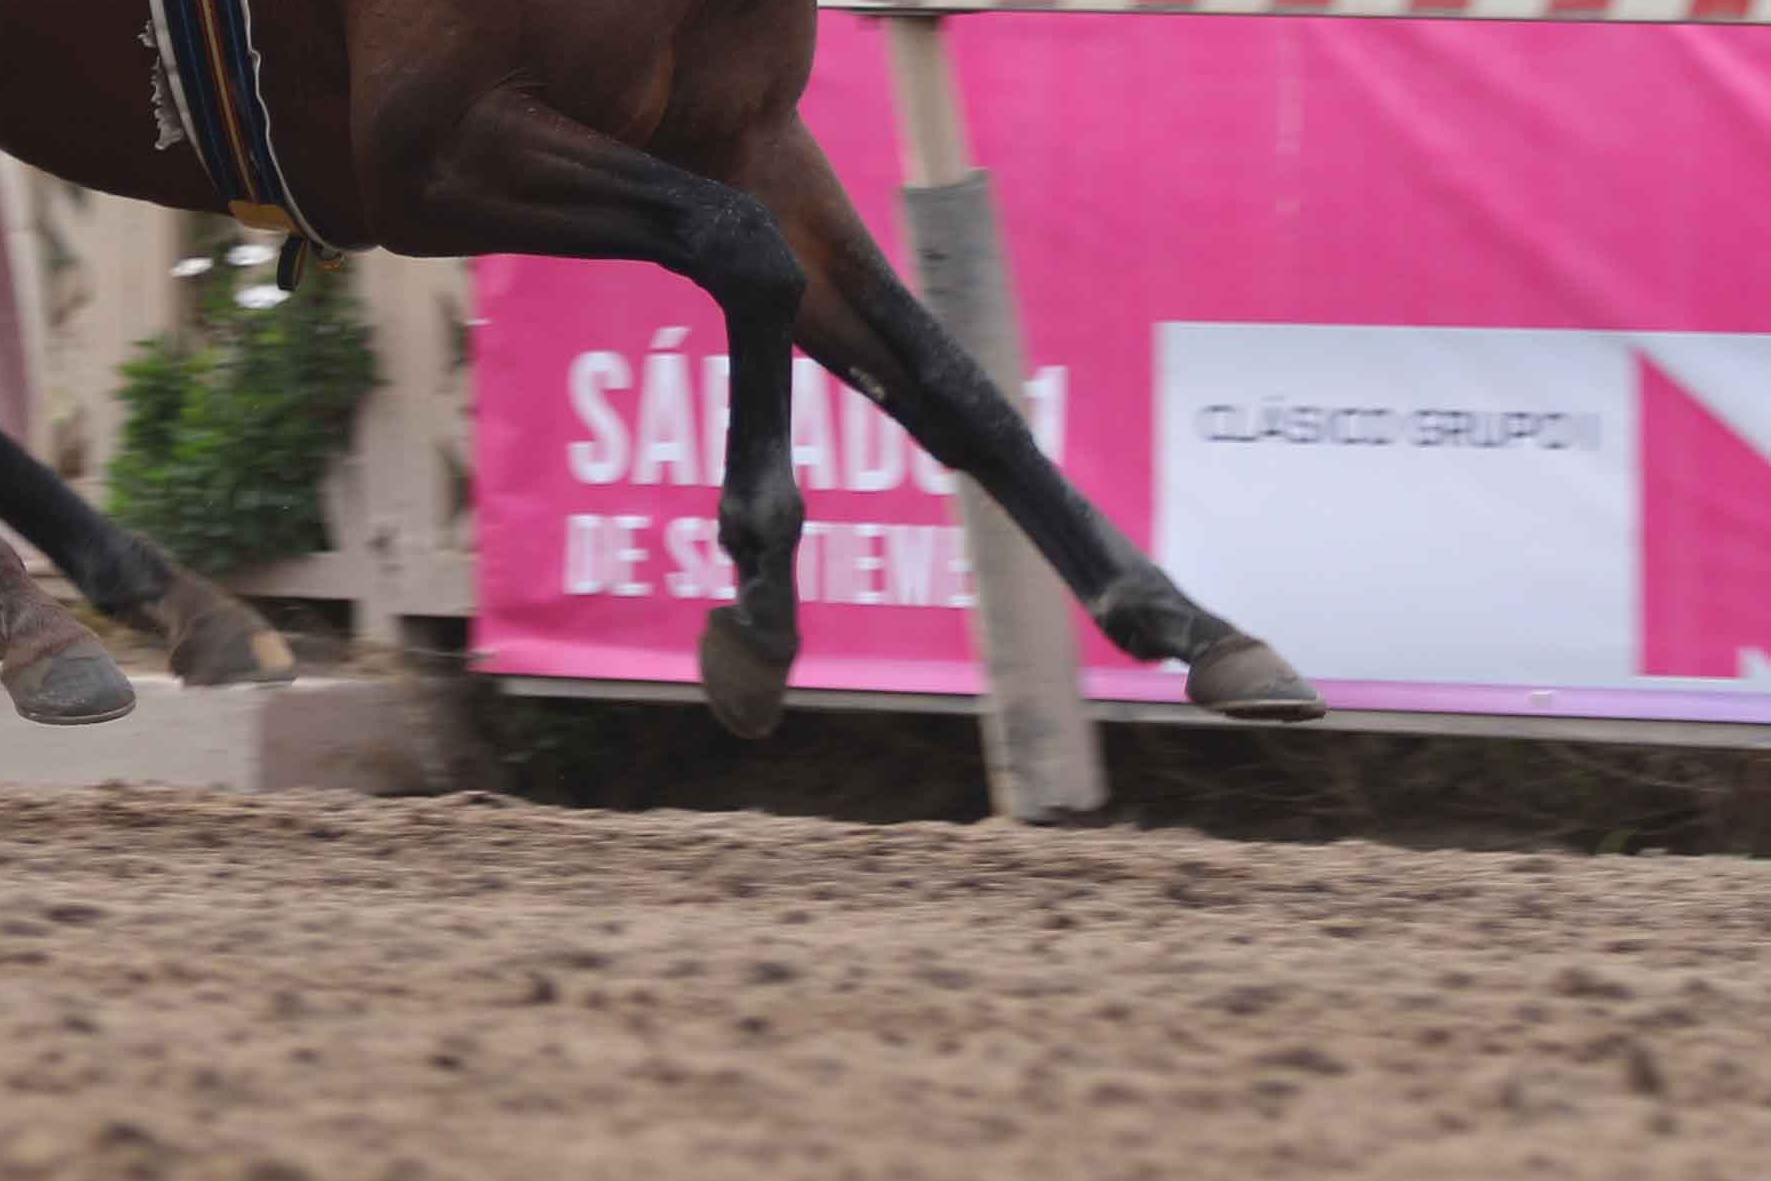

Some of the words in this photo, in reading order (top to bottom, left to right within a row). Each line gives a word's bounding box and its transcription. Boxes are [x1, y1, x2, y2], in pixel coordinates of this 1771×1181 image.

[1198, 395, 1393, 445] CLÁSICO
[1408, 408, 1572, 453] GRUPO
[564, 514, 653, 597] DE
